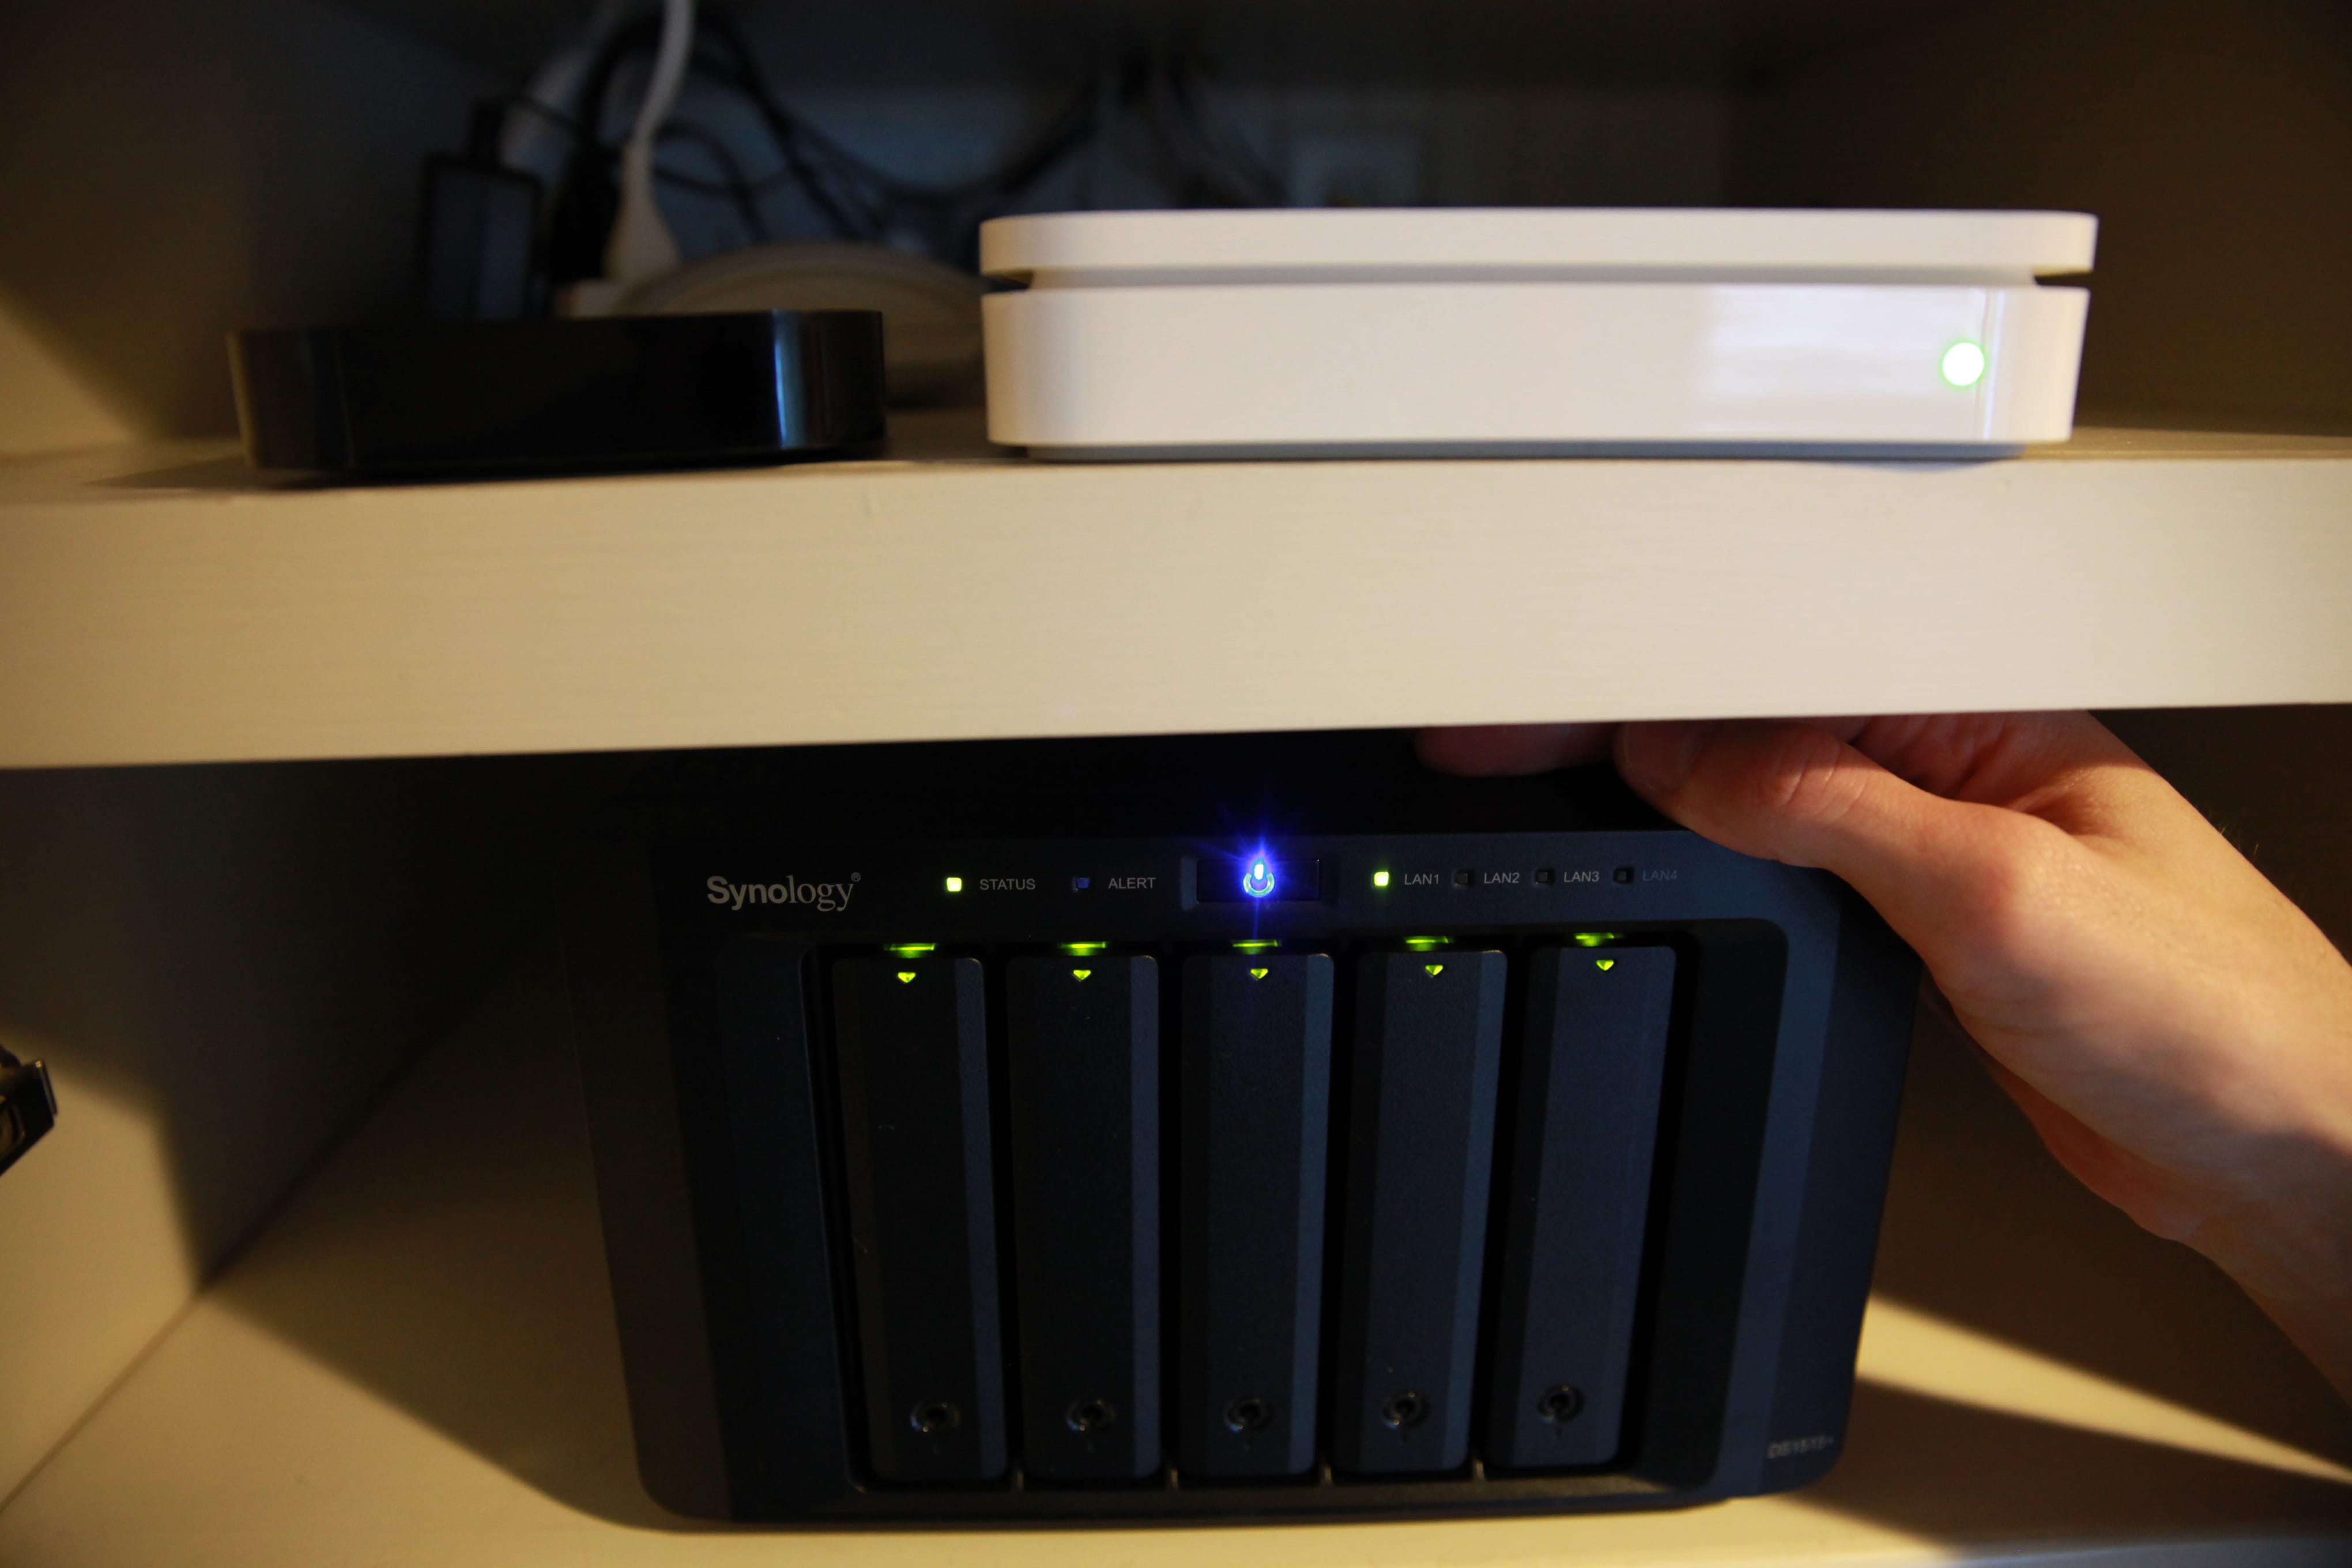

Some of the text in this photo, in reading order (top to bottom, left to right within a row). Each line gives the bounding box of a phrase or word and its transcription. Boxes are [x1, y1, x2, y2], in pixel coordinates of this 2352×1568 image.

[1404, 873, 1439, 885] LAN1
[1483, 872, 1520, 884] LAN2
[1563, 870, 1600, 883] LAN3
[1642, 869, 1678, 881] LAN4
[979, 878, 1036, 891] STATUS
[1108, 877, 1156, 889] ALERT
